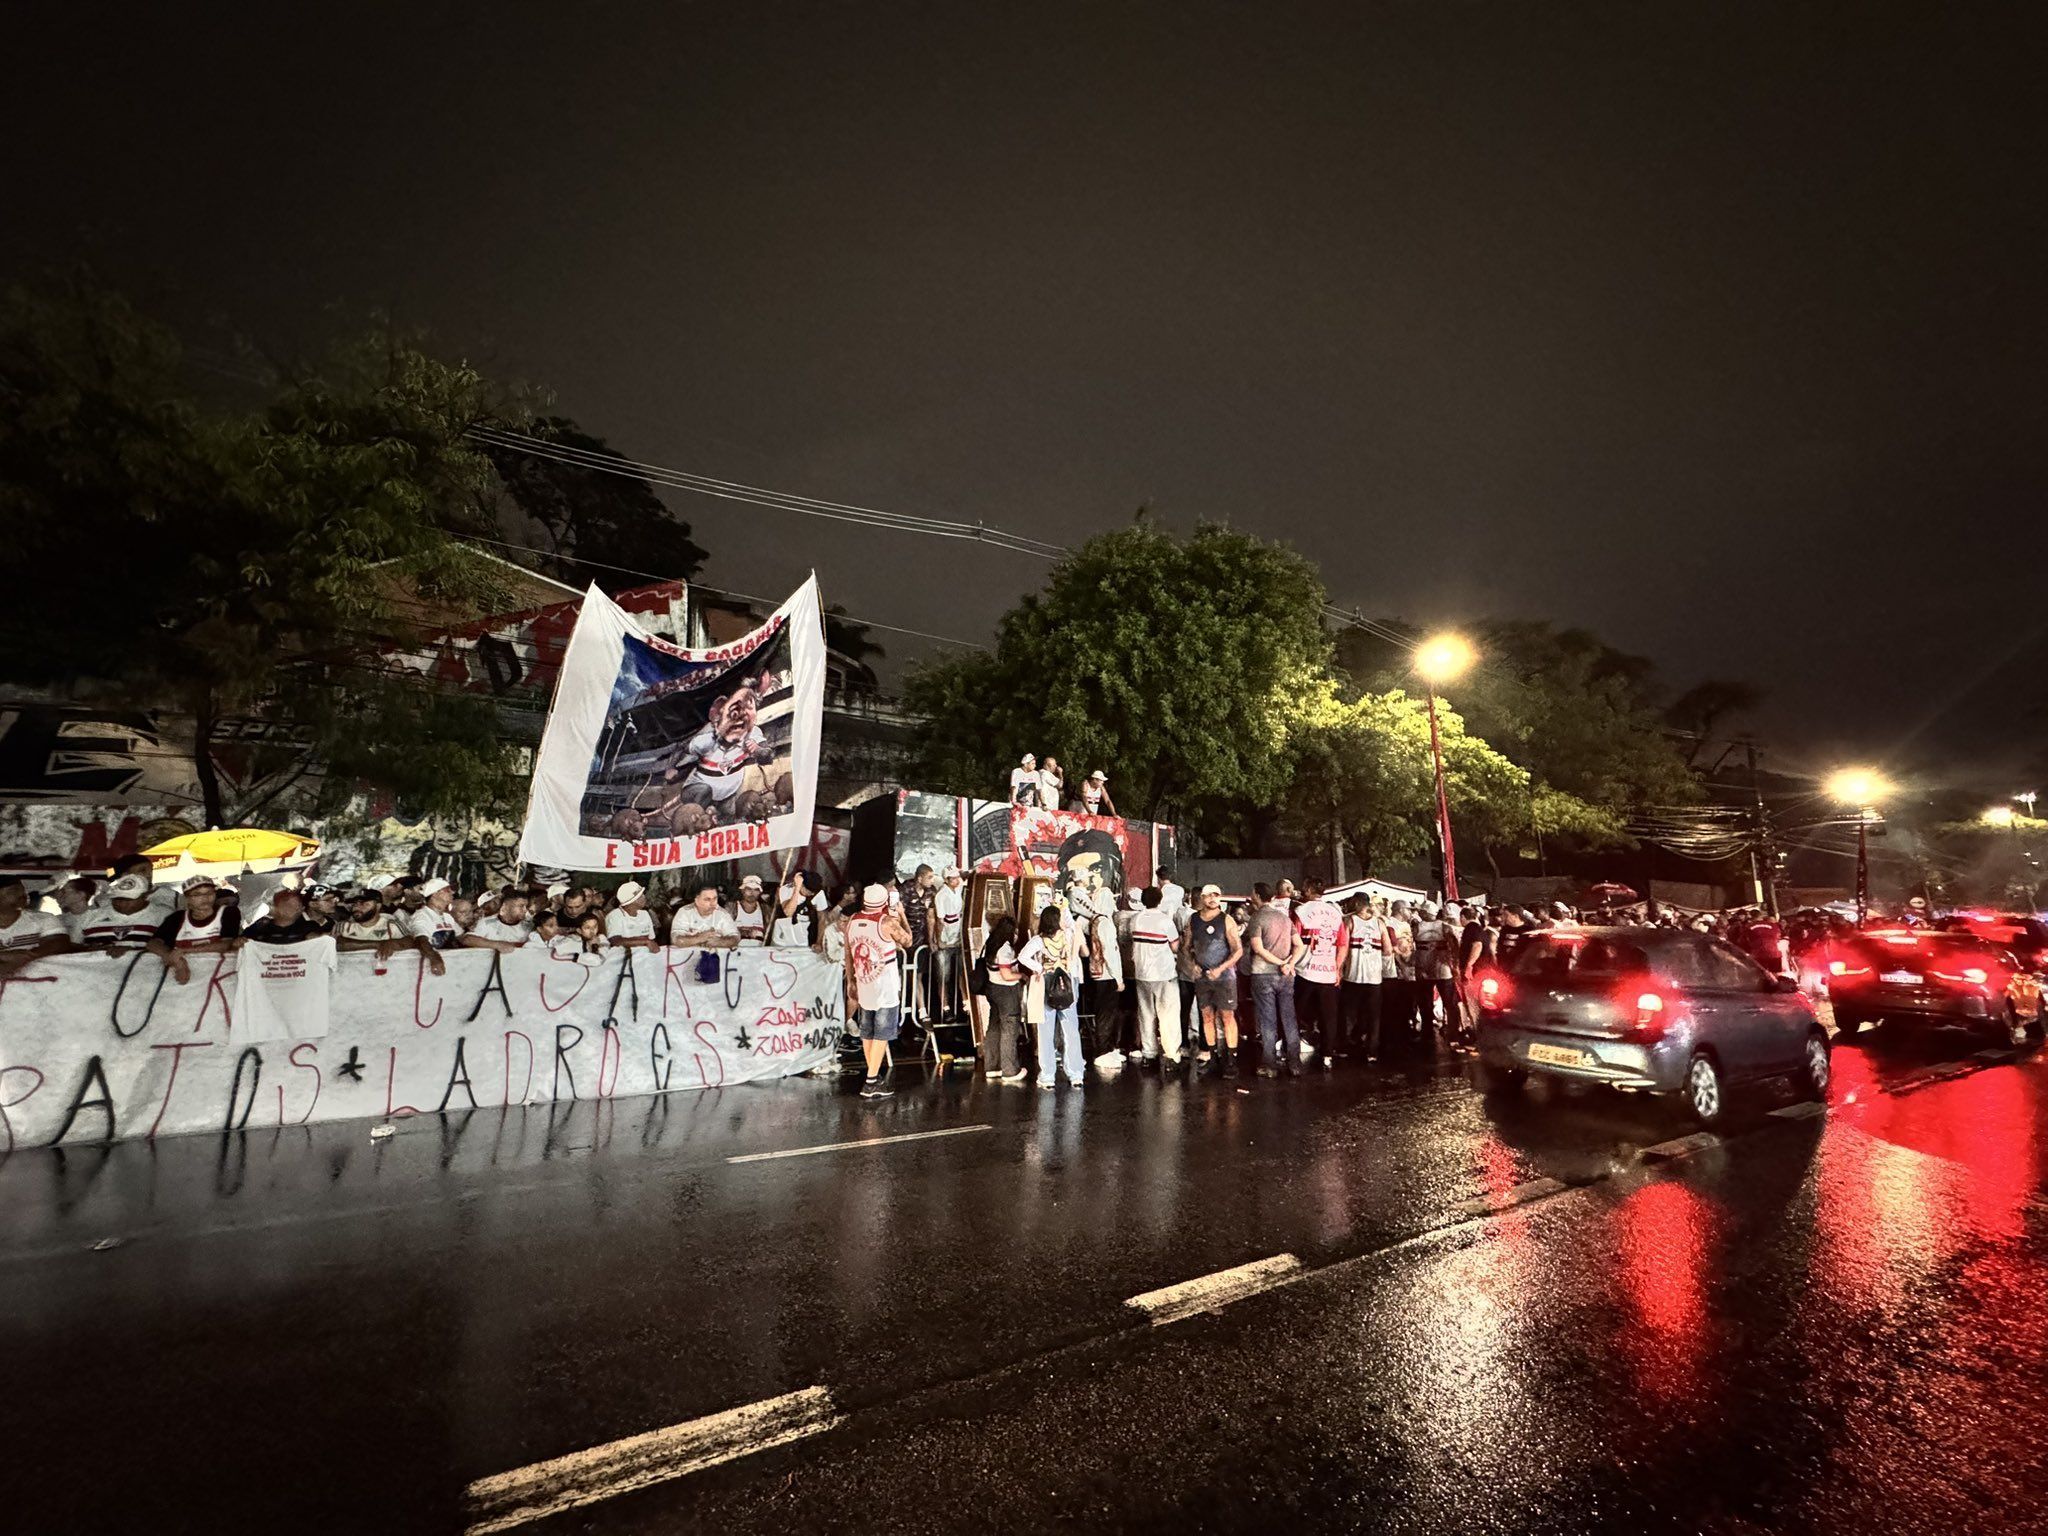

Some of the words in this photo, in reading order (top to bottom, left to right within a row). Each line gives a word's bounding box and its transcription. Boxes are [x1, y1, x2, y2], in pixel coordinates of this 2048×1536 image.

[605, 844, 618, 868] E
[633, 844, 681, 868] SUA
[695, 824, 770, 860] CORJA
[811, 993, 840, 1022] SUL
